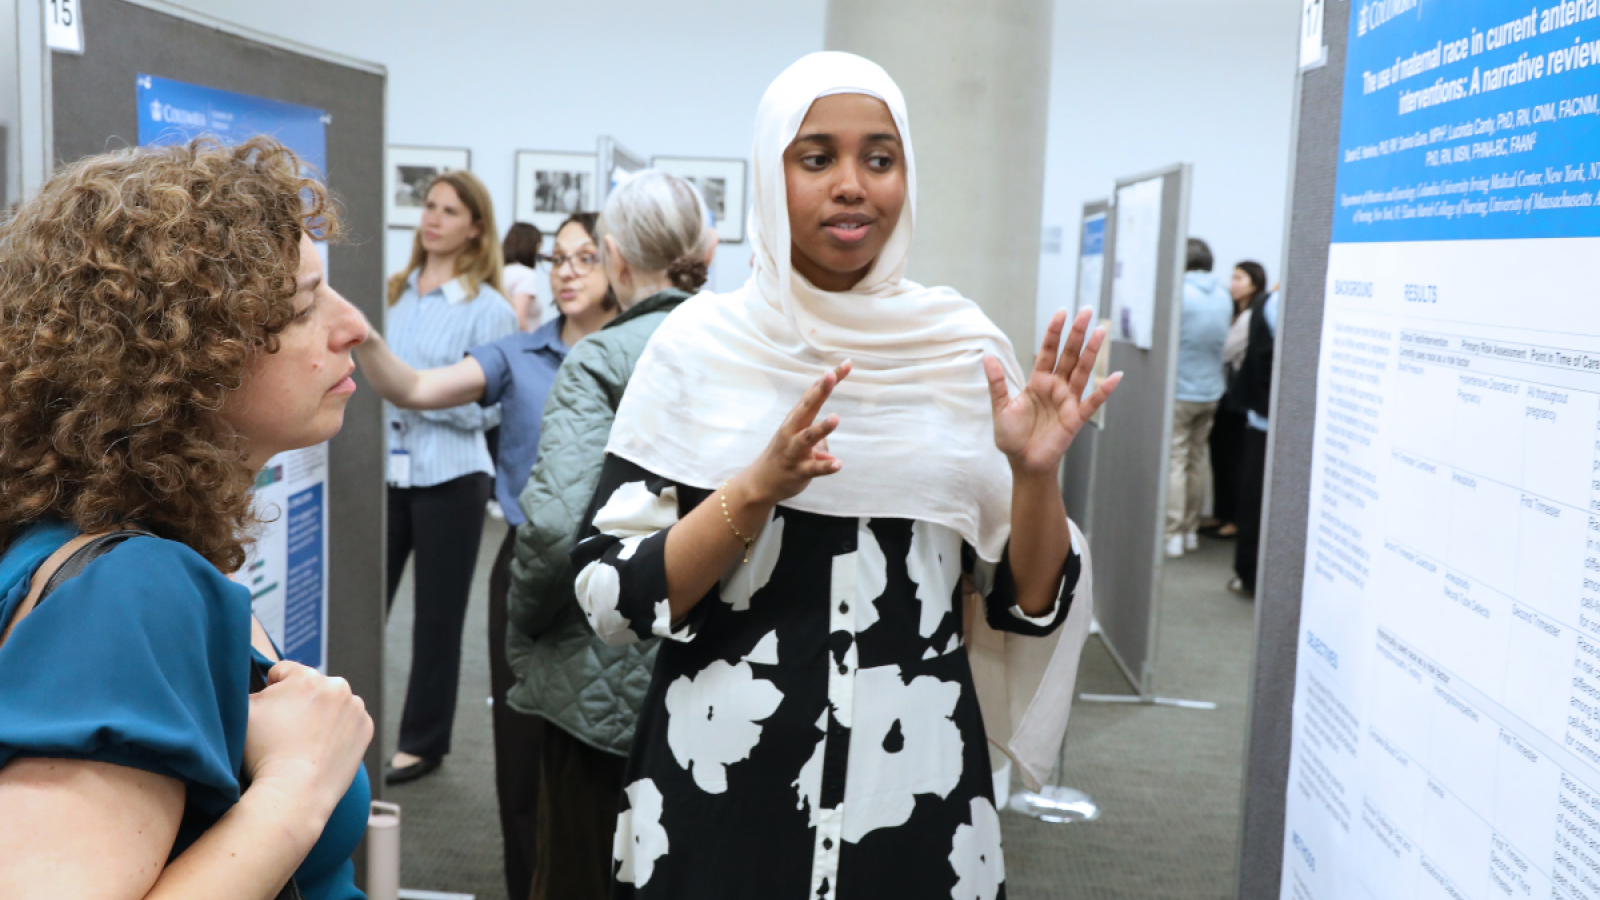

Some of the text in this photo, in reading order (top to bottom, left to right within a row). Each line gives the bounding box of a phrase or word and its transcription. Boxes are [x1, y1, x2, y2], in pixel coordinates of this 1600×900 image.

[51, 0, 73, 27] 15
[1363, 70, 1377, 95] The
[1377, 67, 1391, 91] use
[1400, 40, 1442, 81] maternal
[1443, 37, 1469, 66] race
[1471, 27, 1484, 56] in
[1486, 6, 1538, 51] current
[1399, 36, 1600, 116] interventions: A narrative review
[1555, 351, 1572, 367] Time
[1573, 353, 1581, 367] of
[1582, 354, 1600, 371] Care
